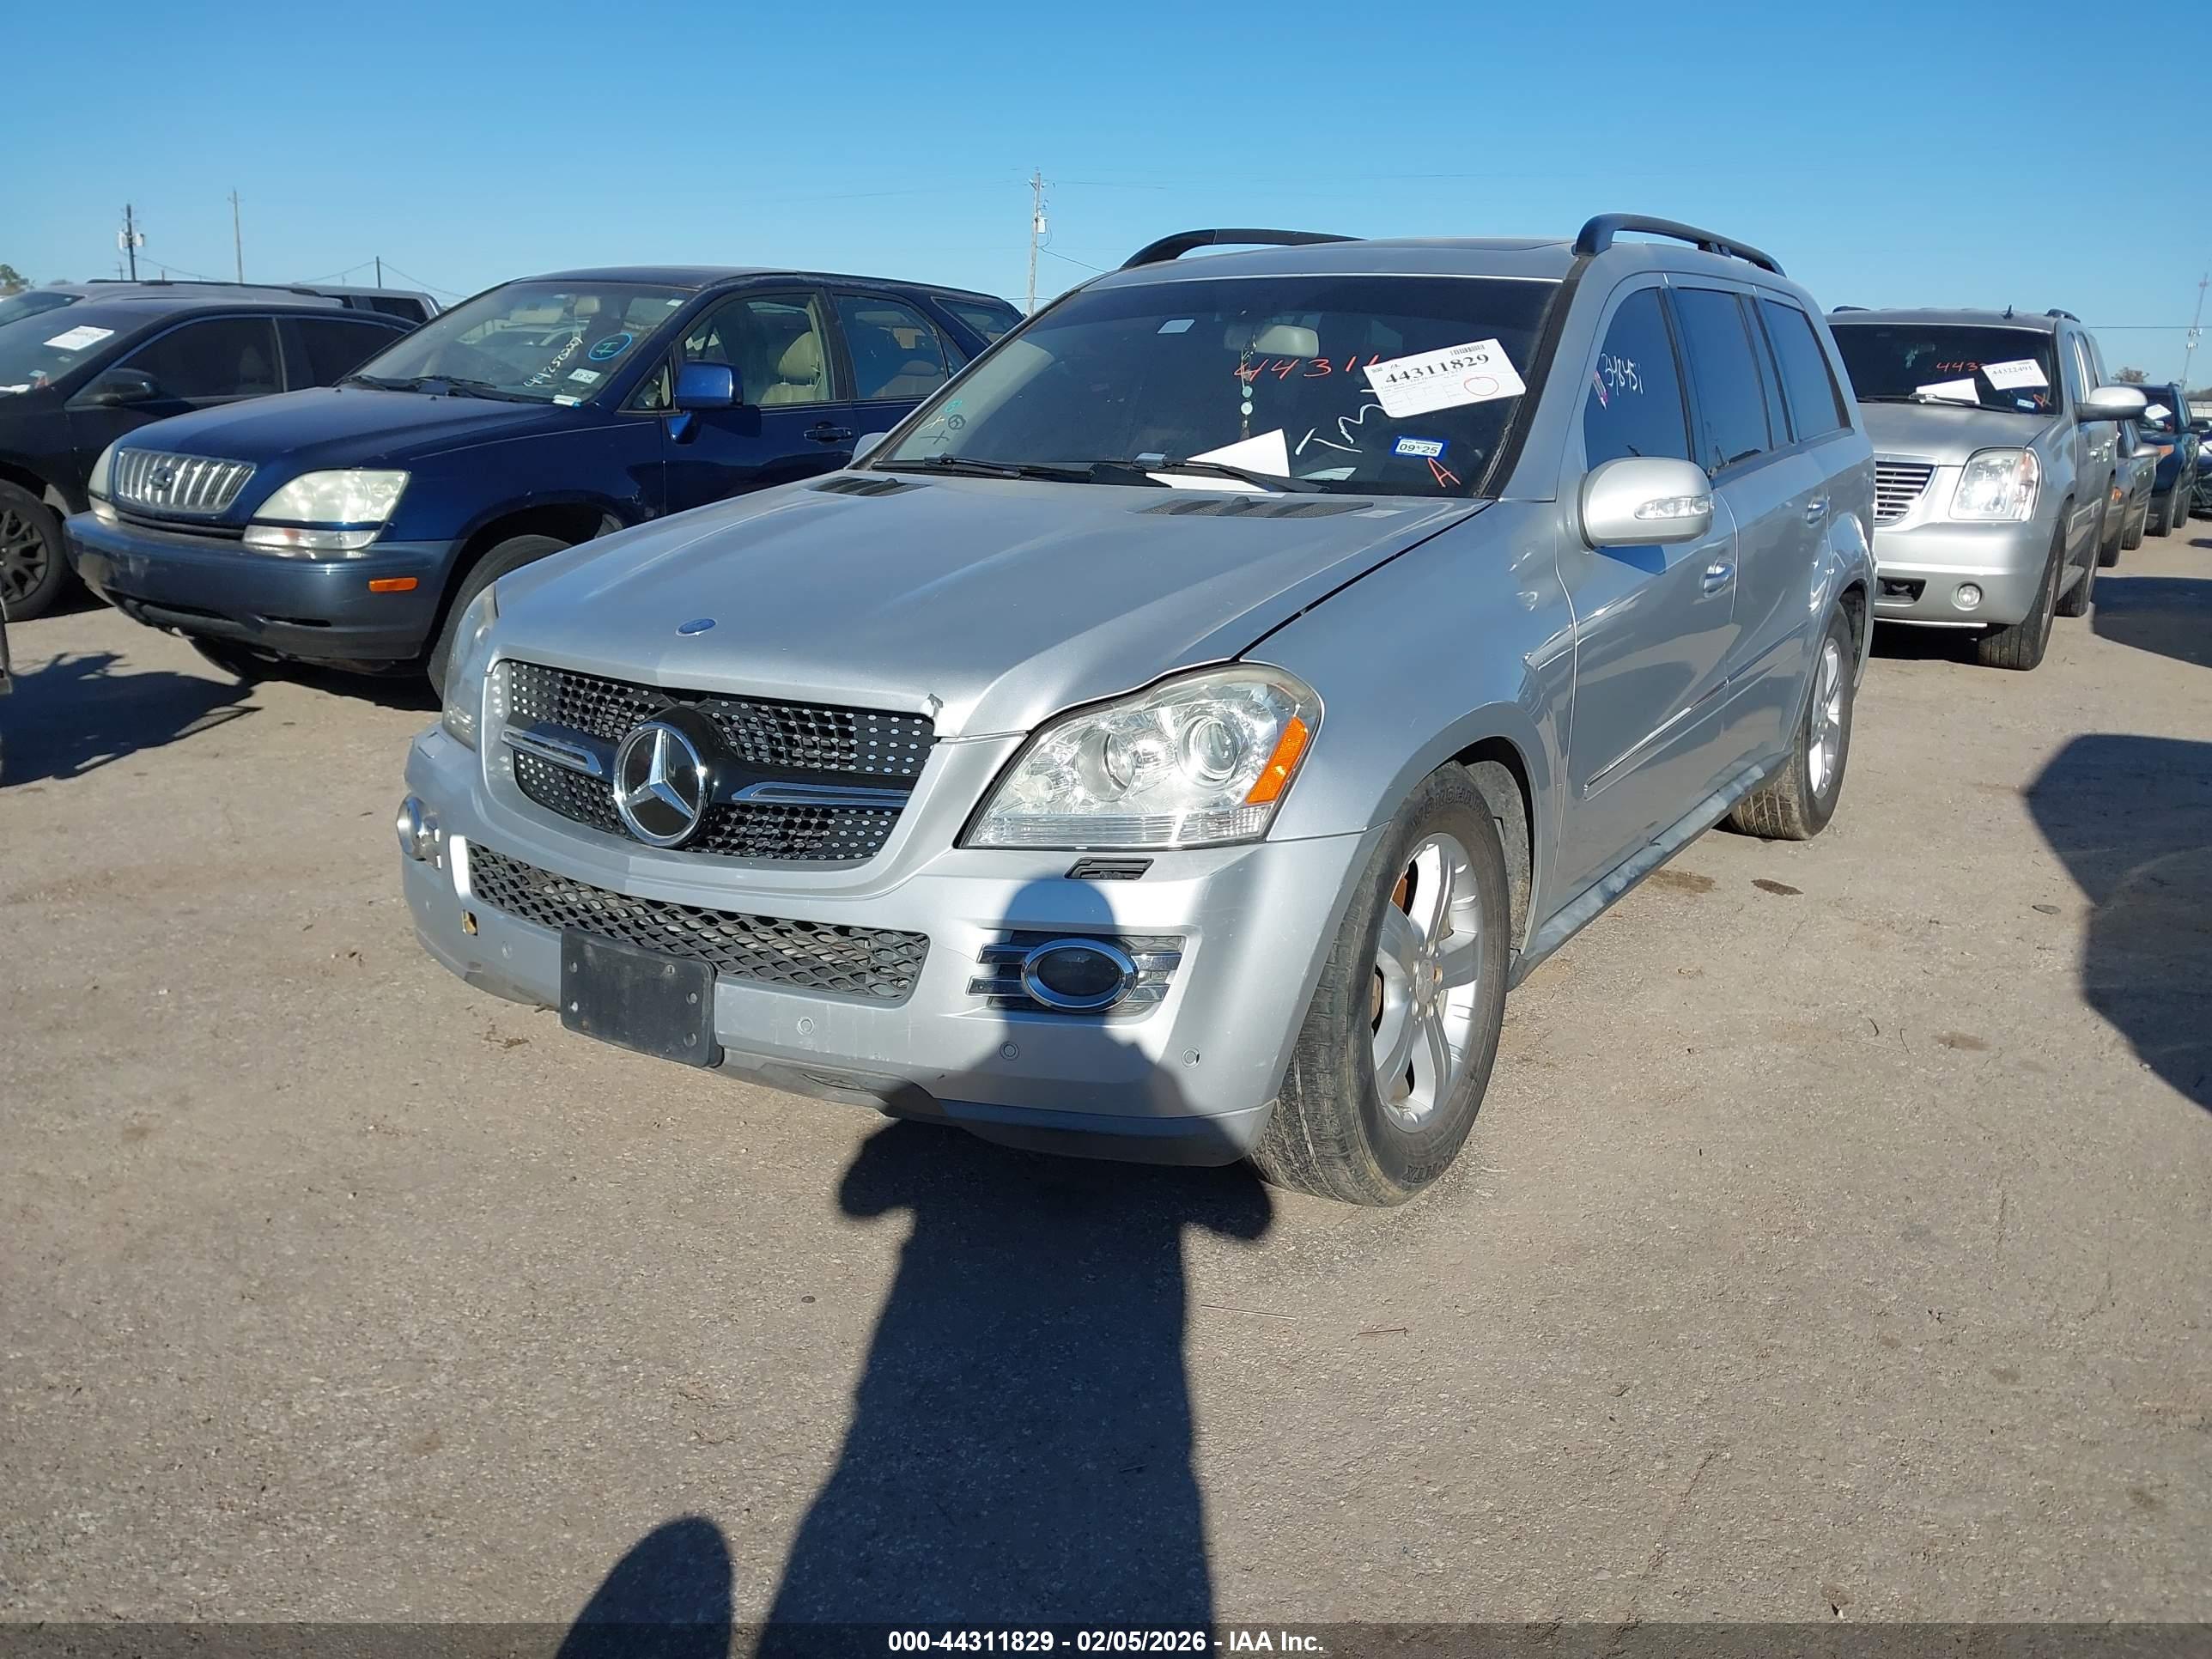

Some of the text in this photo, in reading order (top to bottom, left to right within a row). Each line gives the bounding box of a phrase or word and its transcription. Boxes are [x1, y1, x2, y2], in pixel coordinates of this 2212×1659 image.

[1385, 353, 1490, 384] 44311829
[1936, 362, 1988, 372] 443
[1399, 443, 1439, 454] 09 25
